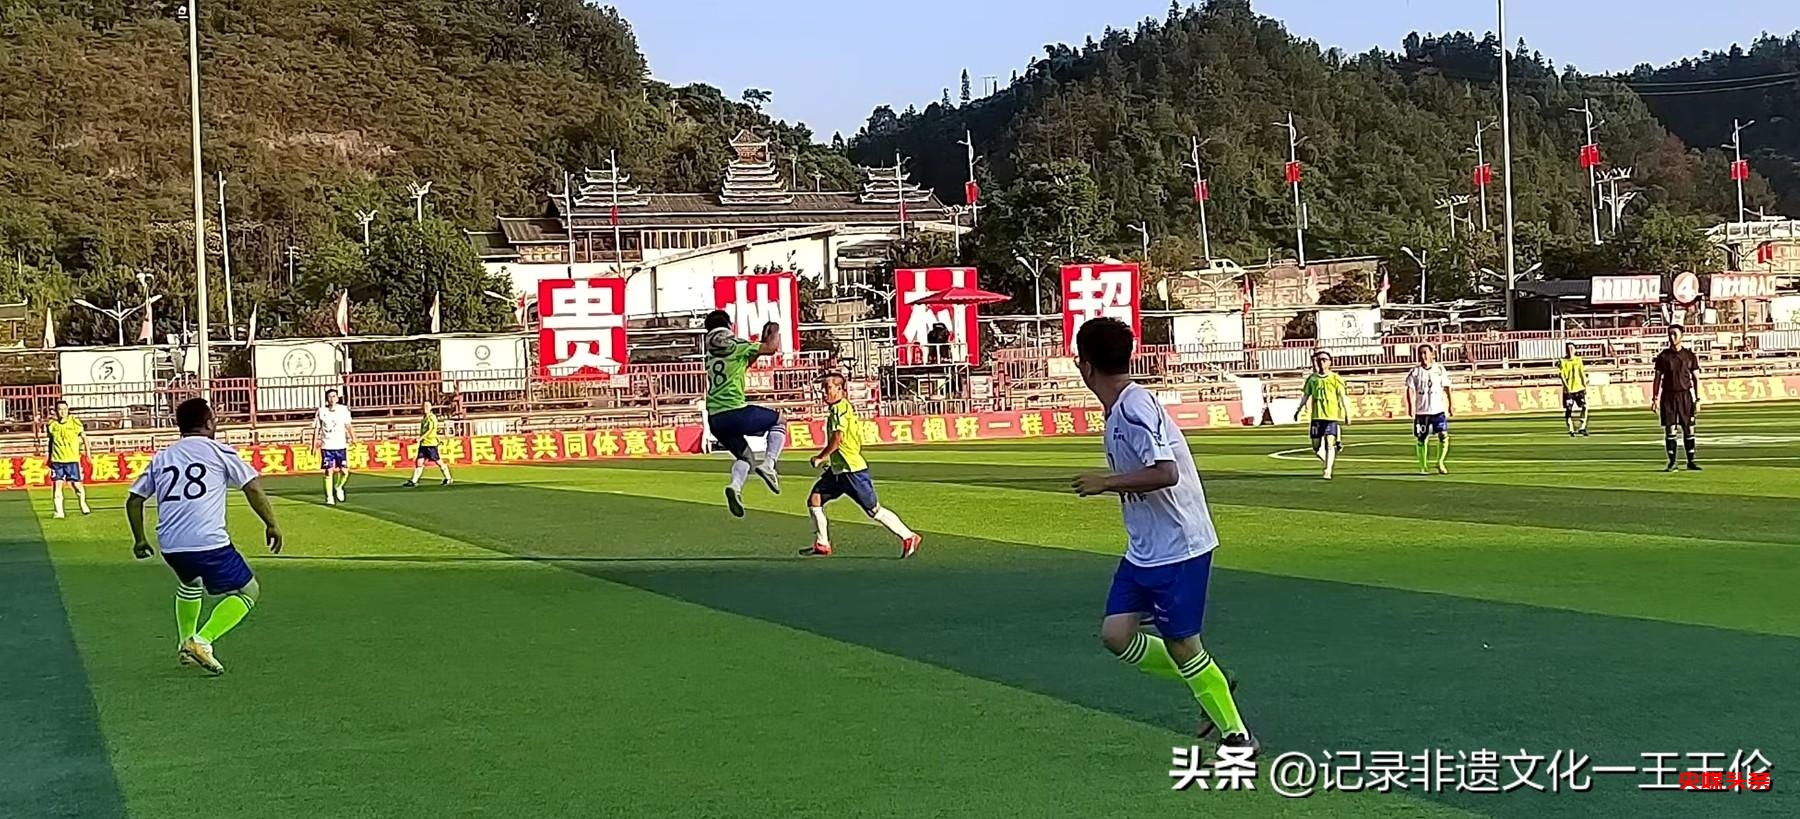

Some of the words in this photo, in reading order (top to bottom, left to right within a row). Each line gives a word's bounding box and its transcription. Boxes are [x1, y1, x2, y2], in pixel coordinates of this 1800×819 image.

[542, 278, 624, 376] 贵
[722, 276, 793, 367] 州
[903, 270, 967, 362] 村
[161, 462, 207, 502] 28
